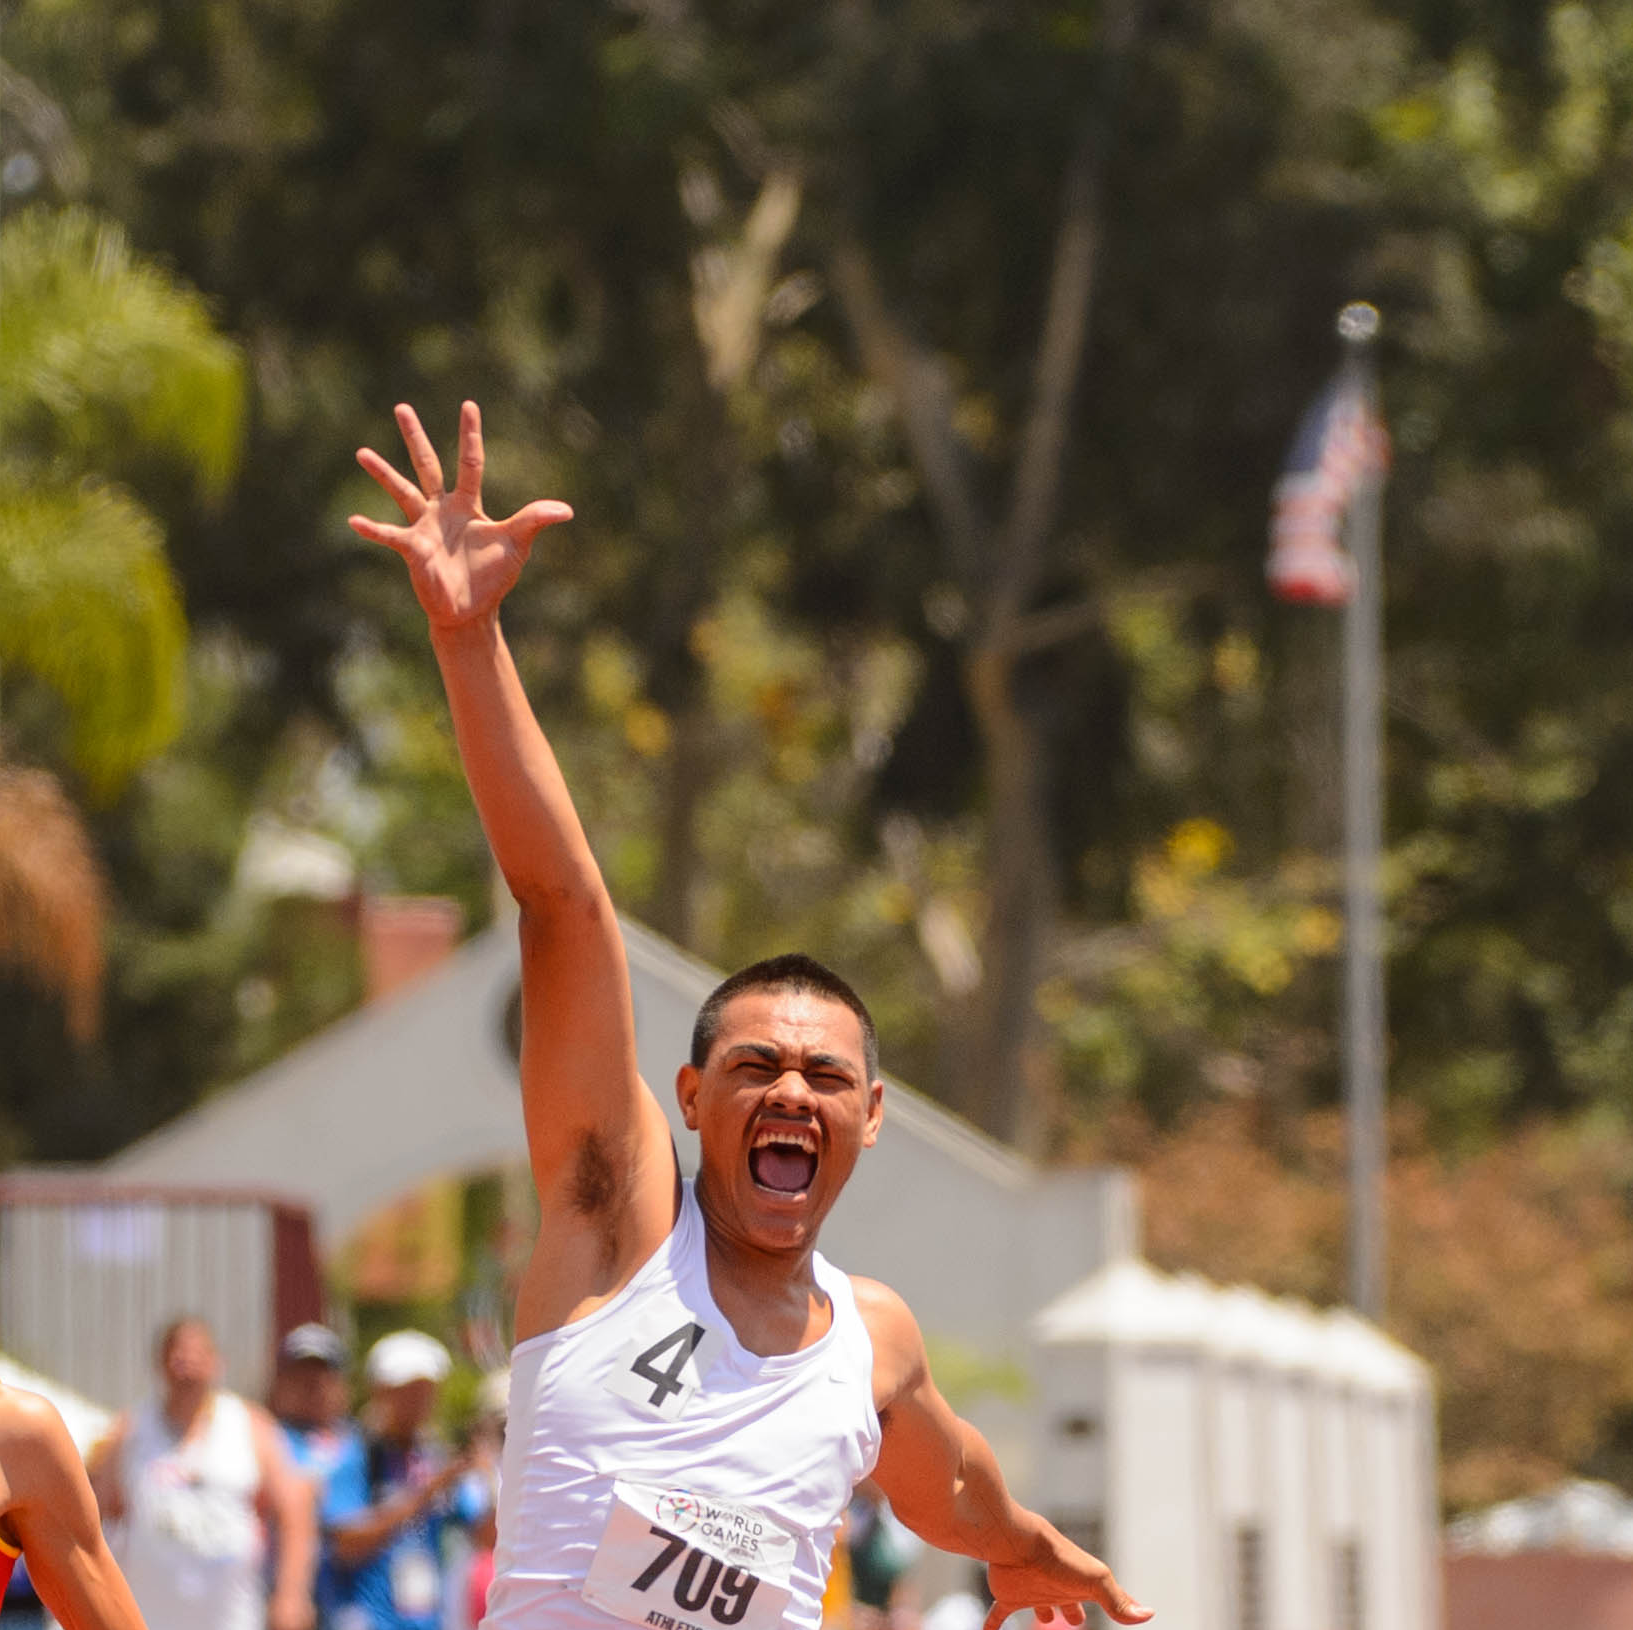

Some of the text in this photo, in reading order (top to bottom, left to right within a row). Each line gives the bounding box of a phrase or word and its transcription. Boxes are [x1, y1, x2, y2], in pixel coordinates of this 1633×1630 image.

[630, 1322, 705, 1407] 4
[630, 1526, 760, 1625] 709
[701, 1523, 759, 1552] GAMES
